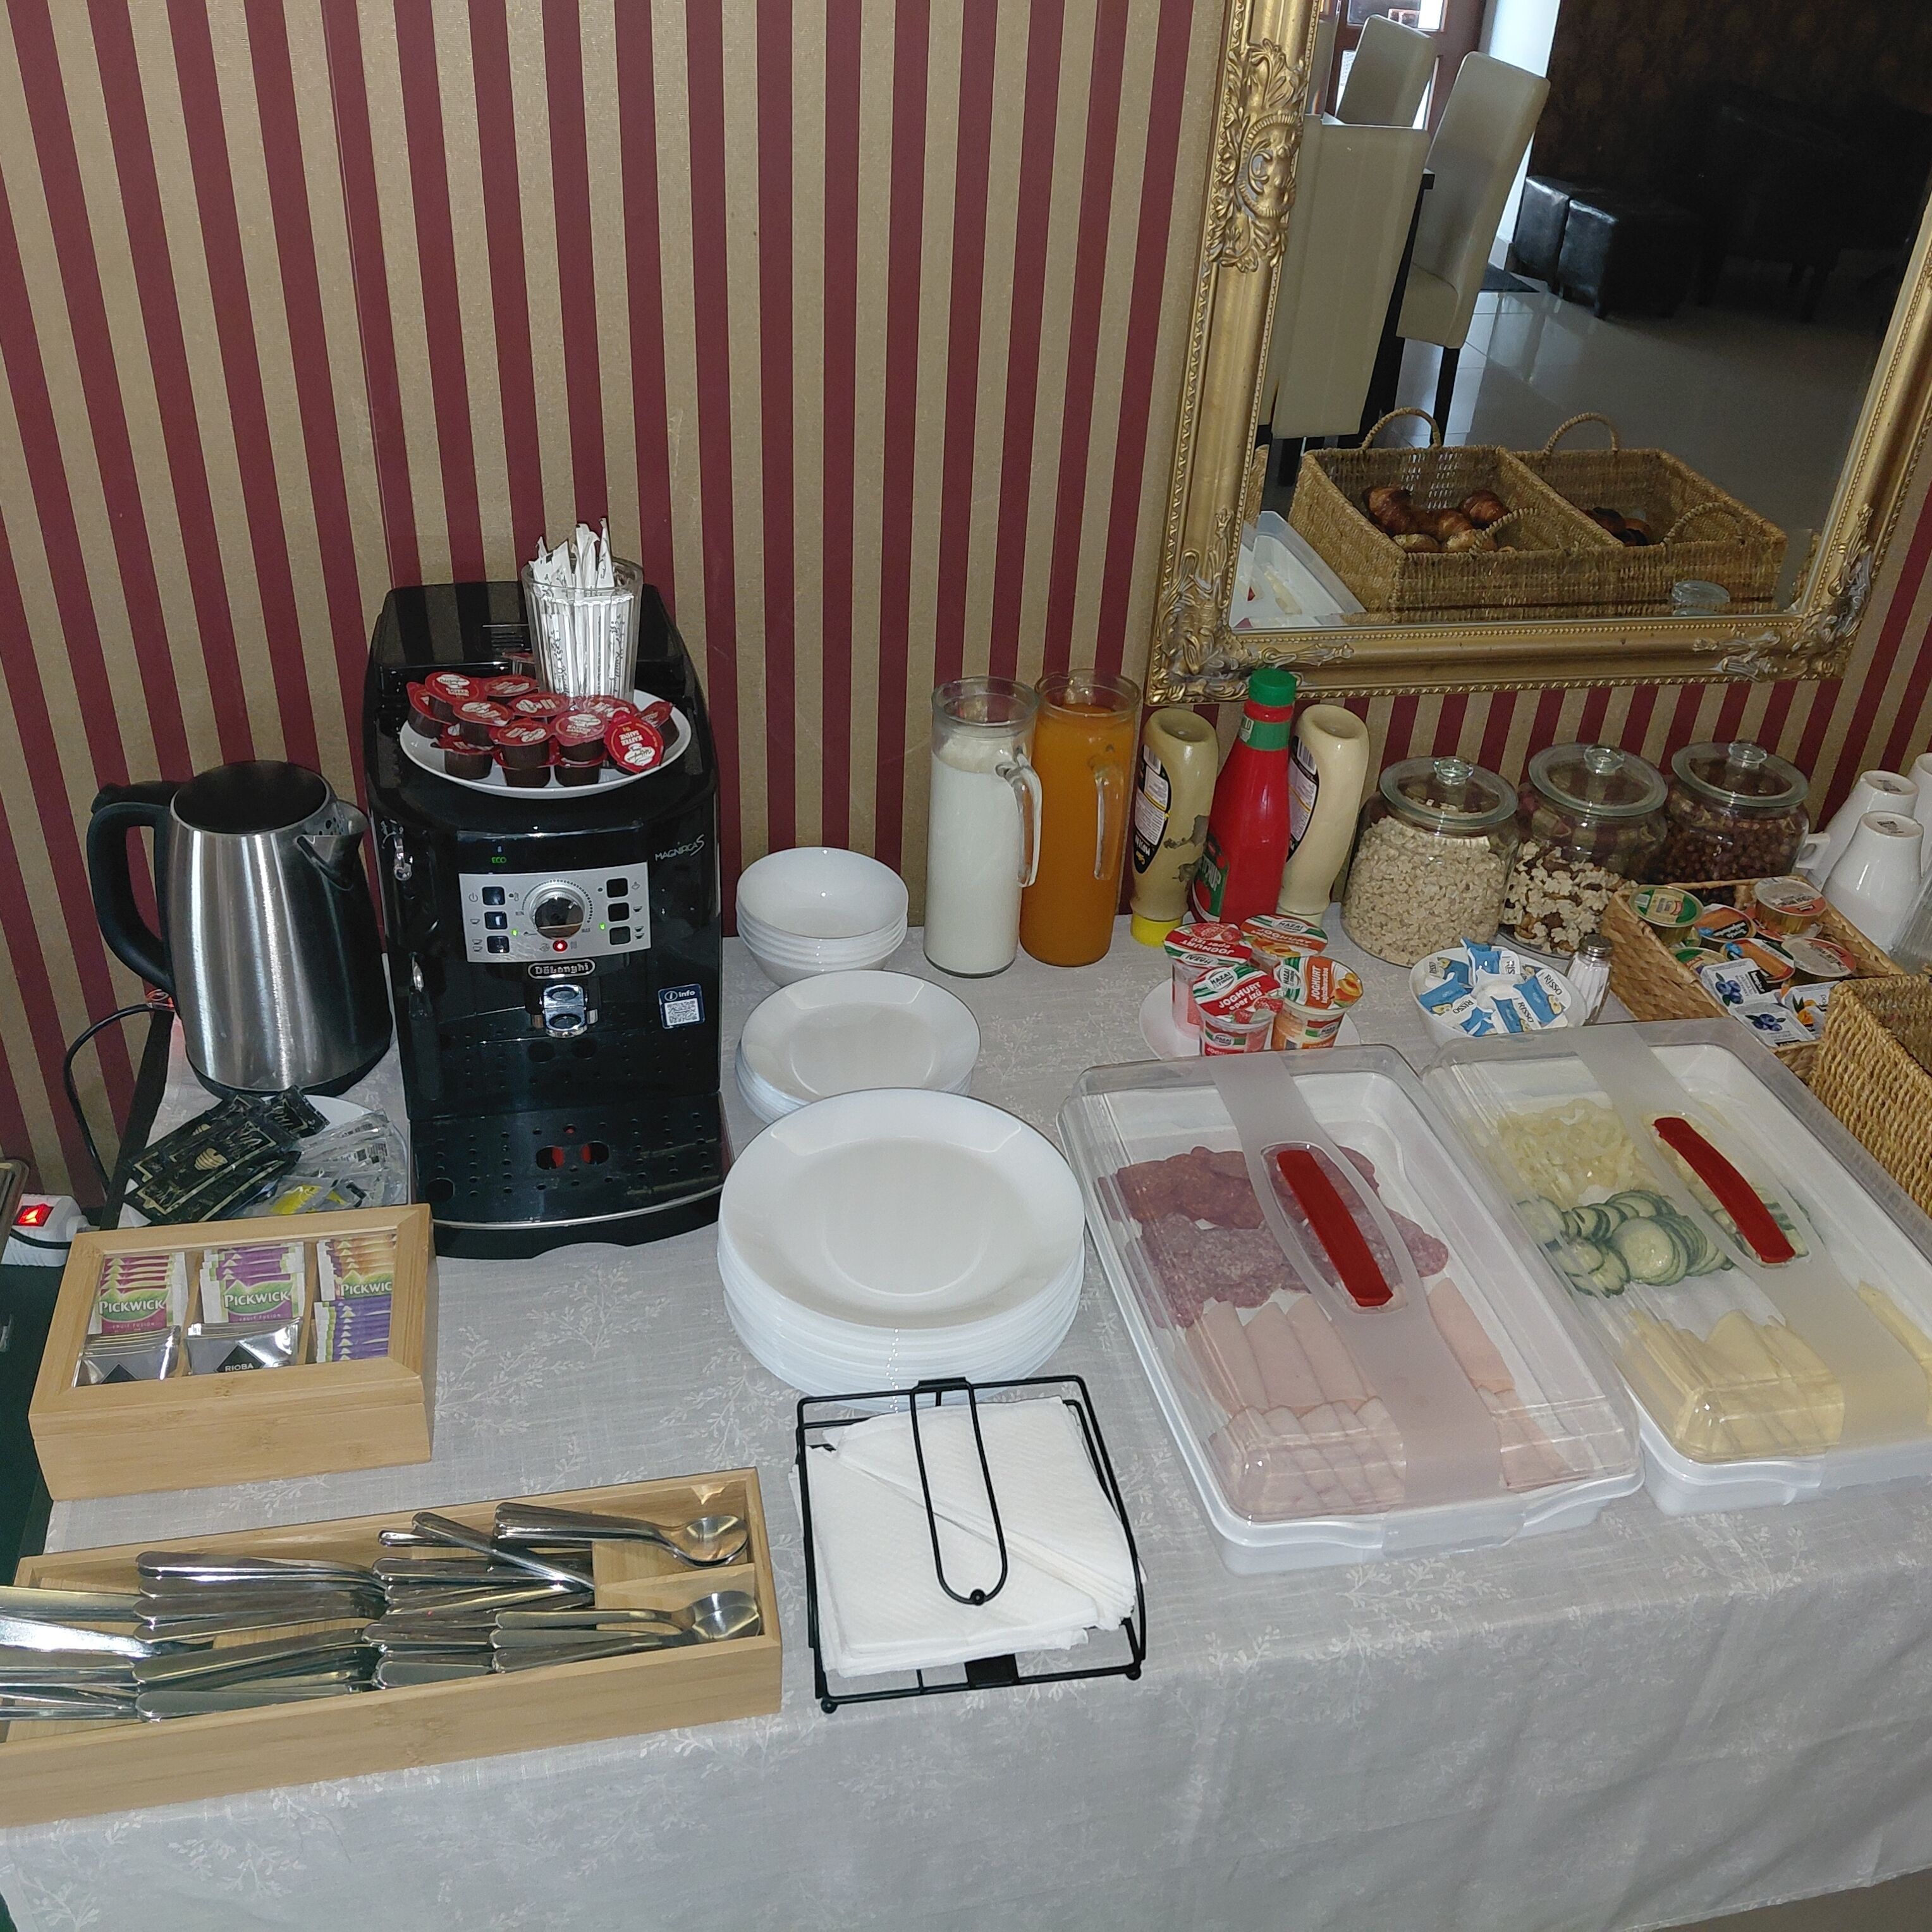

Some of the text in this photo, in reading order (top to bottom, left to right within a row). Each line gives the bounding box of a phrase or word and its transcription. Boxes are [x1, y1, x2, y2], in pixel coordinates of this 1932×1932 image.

[1179, 940, 1235, 955] JOGHURT
[1210, 972, 1231, 985] HAZAI
[1311, 965, 1321, 1000] JOGHURT
[1544, 974, 1563, 996] RISSO
[1218, 982, 1261, 1008] JOGHURT
[1228, 998, 1248, 1011] eper
[1452, 999, 1474, 1015] RISSO
[1517, 1001, 1534, 1023] RISSO
[99, 1300, 167, 1314] PICKWICK
[224, 1291, 290, 1307] PICKWICK
[225, 1363, 254, 1372] RIOBA
